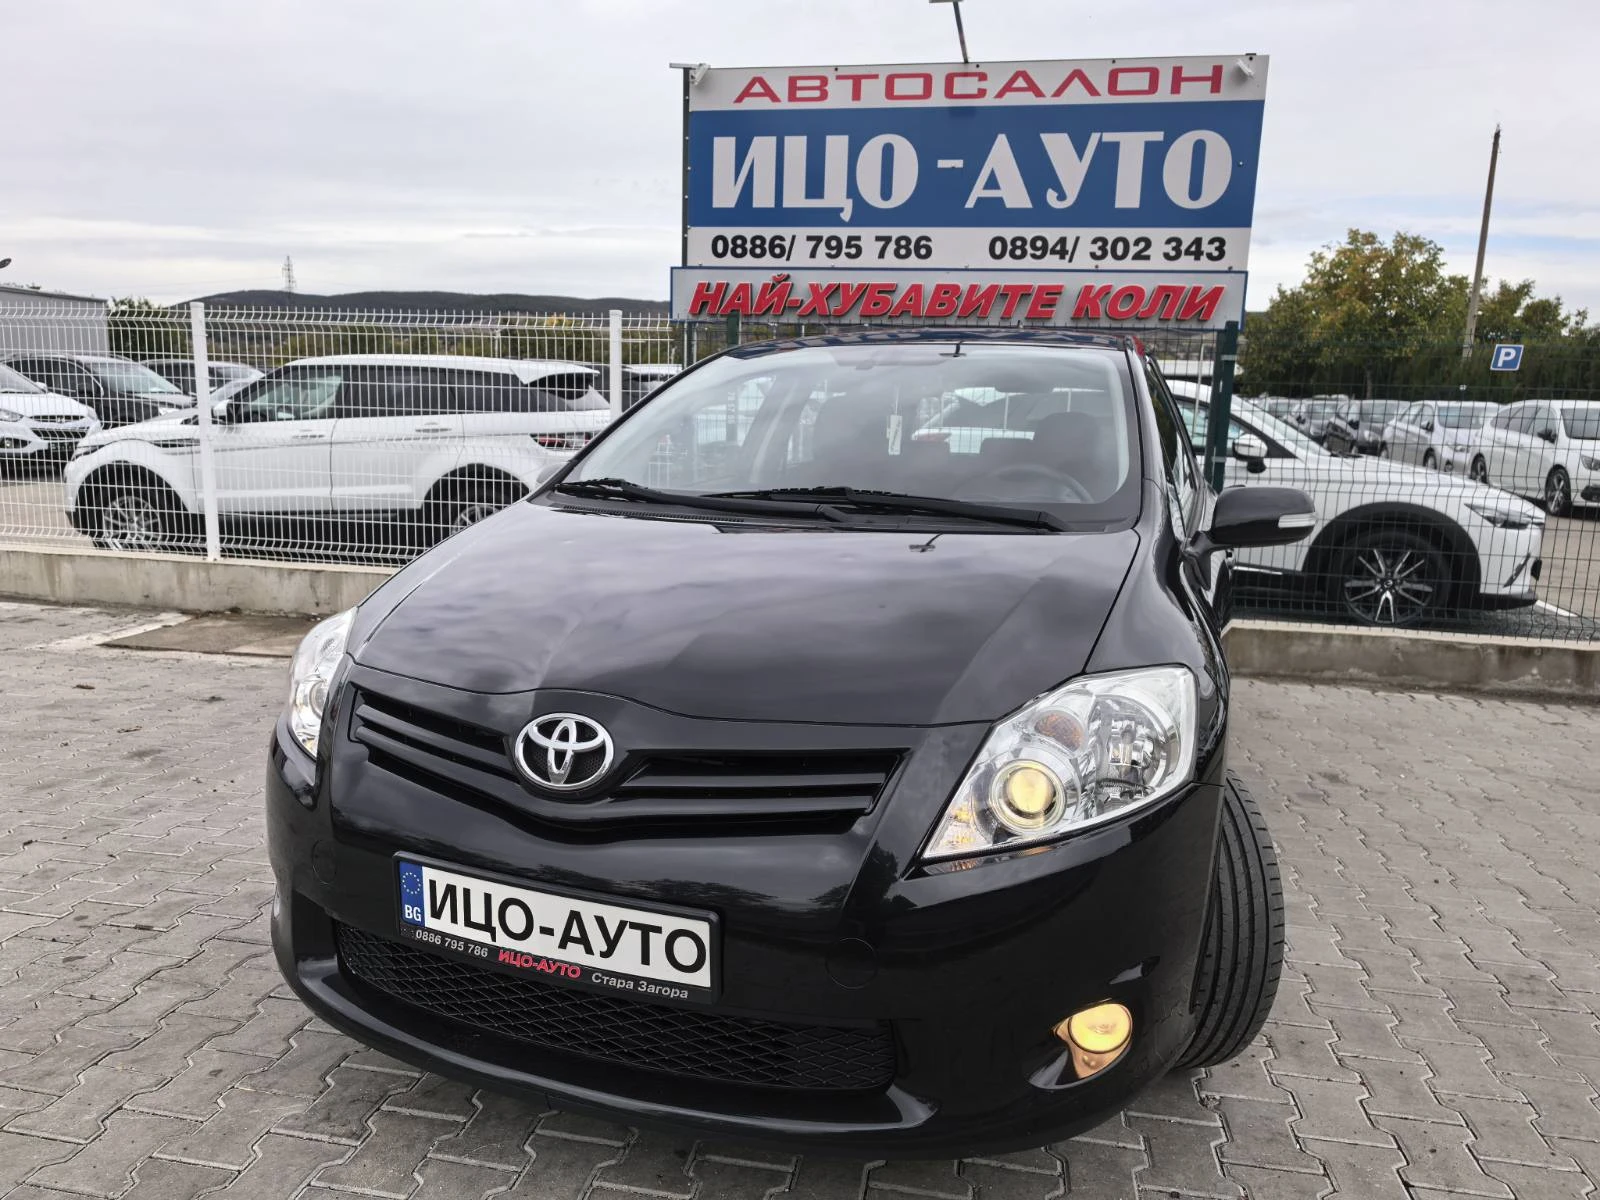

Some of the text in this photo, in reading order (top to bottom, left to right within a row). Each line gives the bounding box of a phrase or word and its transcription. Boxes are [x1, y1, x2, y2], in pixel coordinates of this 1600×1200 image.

[733, 65, 1223, 103] АВТОСАЛОН
[711, 234, 933, 261] 0886/ 795 786
[988, 235, 1226, 263] 0894/ 302 343
[688, 273, 1226, 321] НАЙ-ХУБАВИТЕ КОЛИ
[1497, 347, 1516, 367] P
[404, 904, 421, 922] BG
[429, 879, 706, 974] ИЦО-АУТО
[416, 929, 689, 999] 0886 795 786 ИЦО-АУТО Стара Загора
